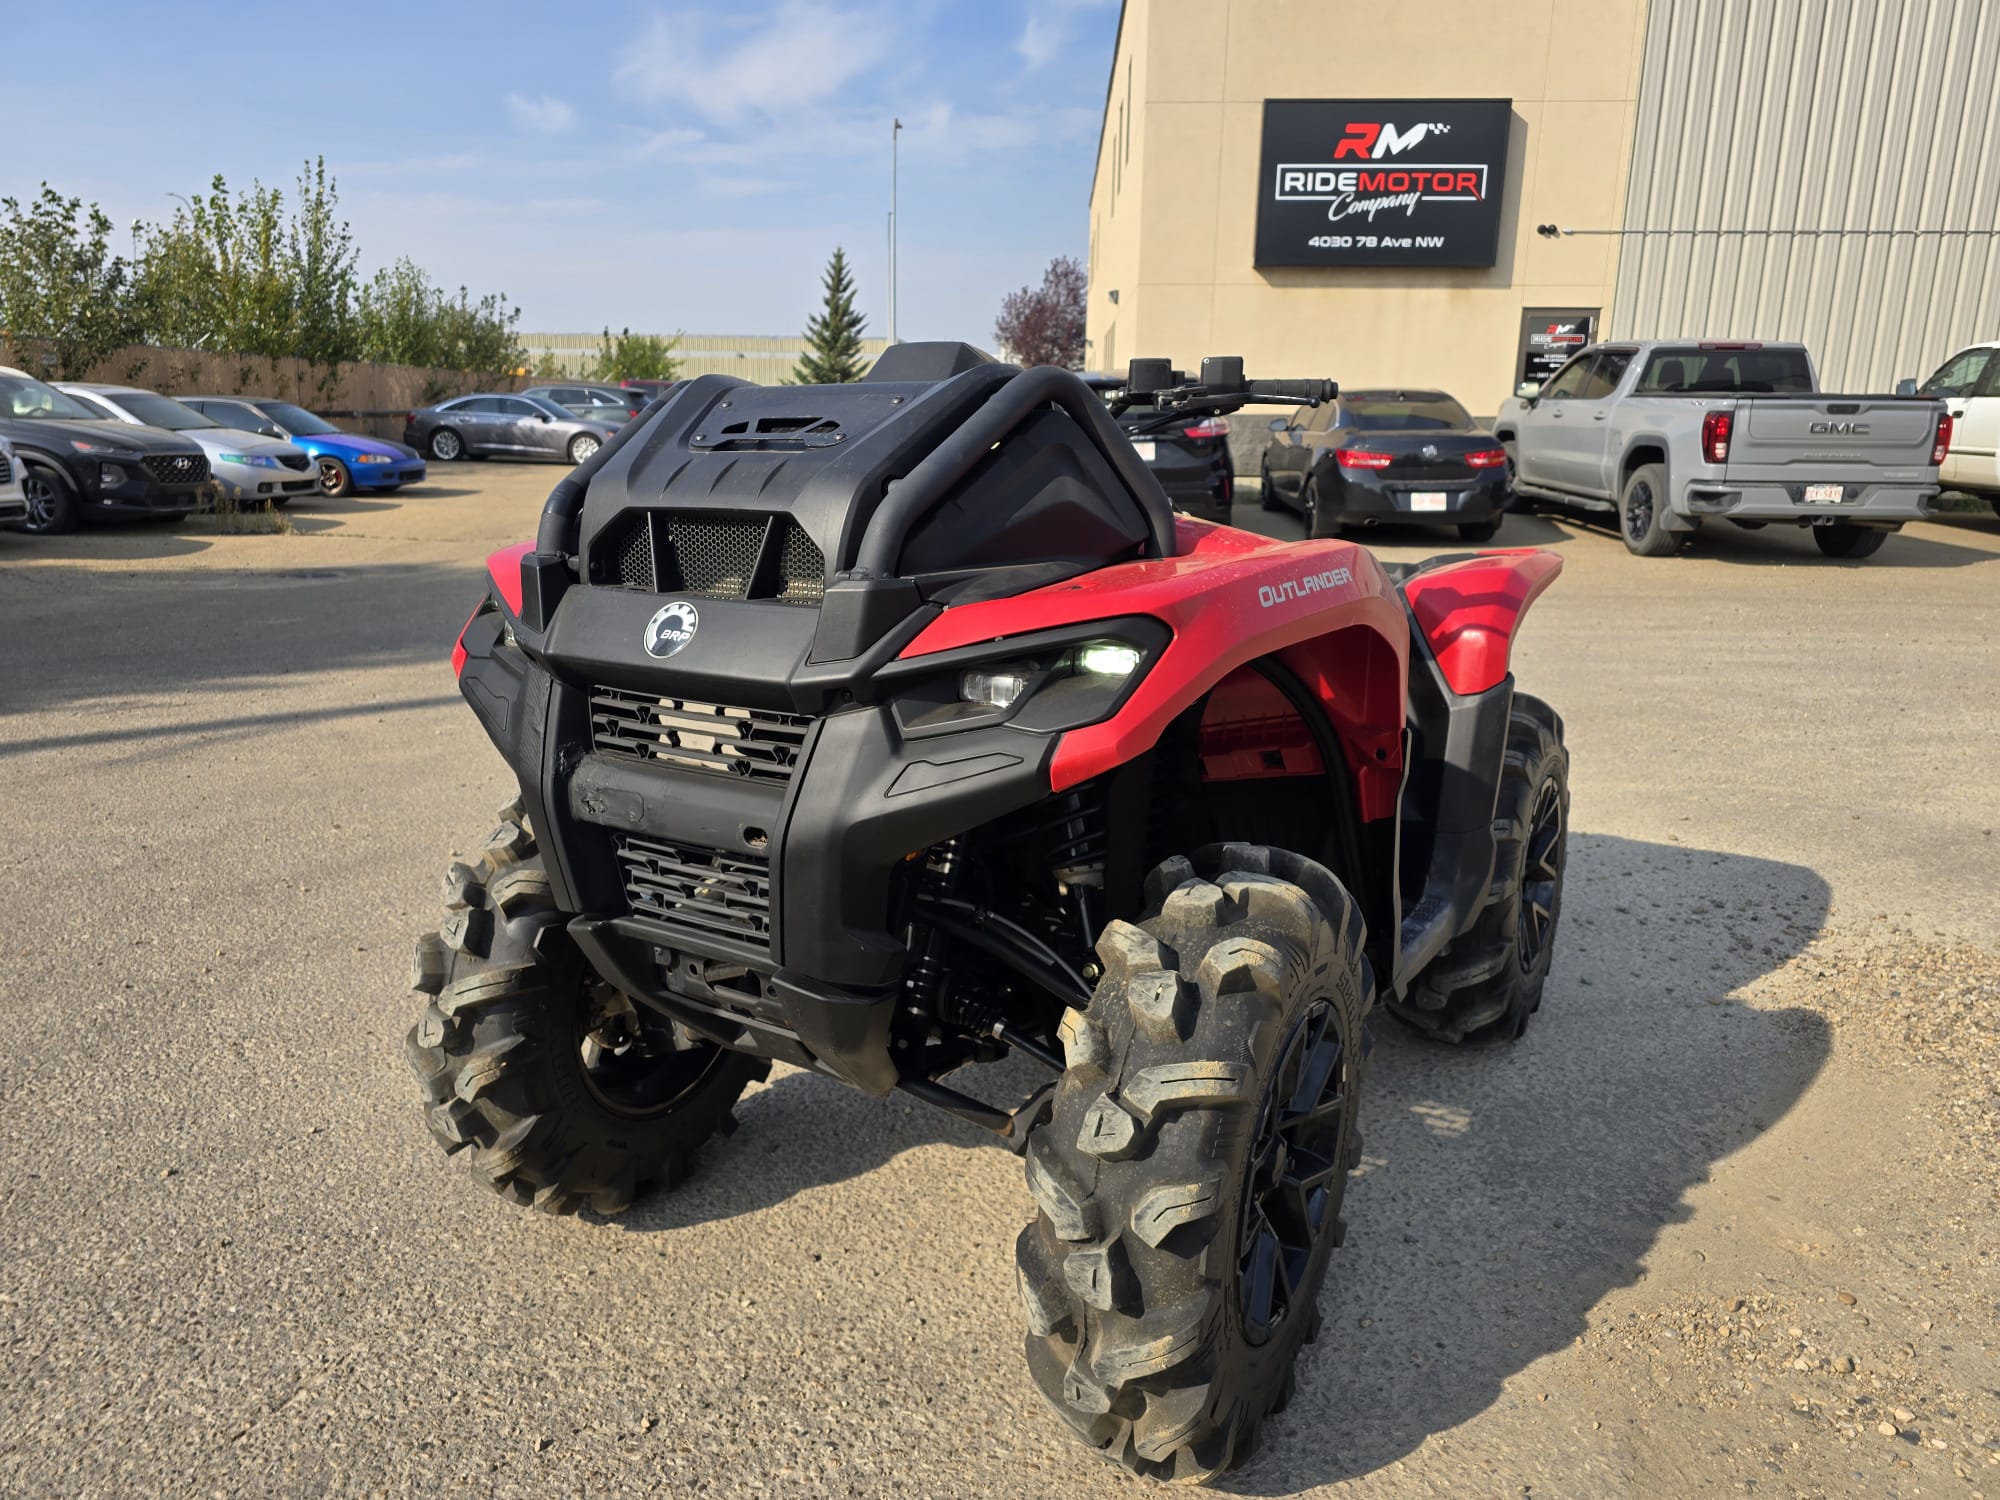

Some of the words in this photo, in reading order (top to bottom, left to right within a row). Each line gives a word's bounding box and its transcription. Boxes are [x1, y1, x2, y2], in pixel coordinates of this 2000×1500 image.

[1333, 122, 1430, 159] RM
[1328, 191, 1421, 222] Company
[1308, 236, 1352, 248] 4030
[1380, 236, 1412, 248] Ave
[1415, 236, 1445, 248] NW
[1809, 421, 1870, 435] GMC
[1258, 567, 1353, 608] OUTLANDER
[660, 629, 691, 642] BRP
